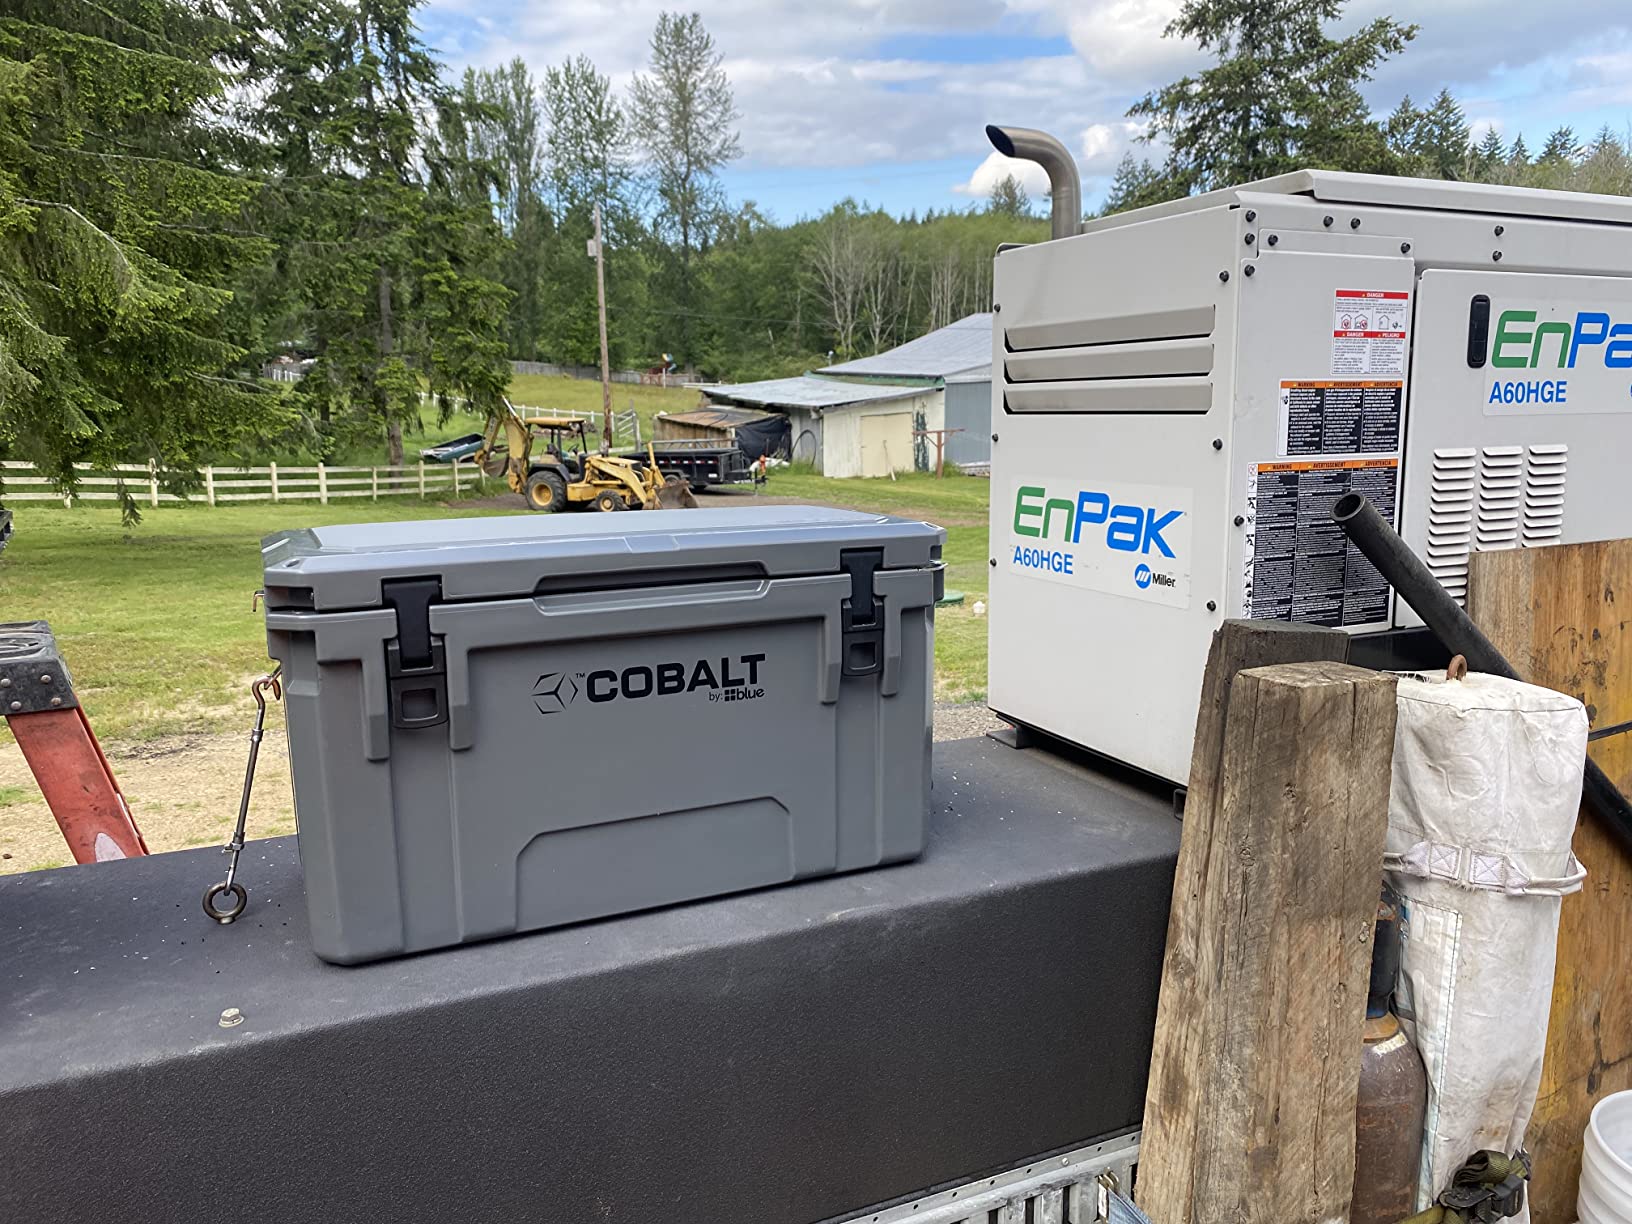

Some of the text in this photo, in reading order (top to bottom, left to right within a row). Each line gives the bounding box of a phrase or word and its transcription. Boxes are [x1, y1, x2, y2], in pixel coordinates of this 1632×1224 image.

[1489, 381, 1567, 404] A60HGE
[1013, 485, 1184, 559] EnPak
[1013, 546, 1074, 575] A60HGE
[1152, 573, 1176, 588] Miller
[586, 653, 766, 702] COBALT
[709, 687, 765, 702] by: blue
